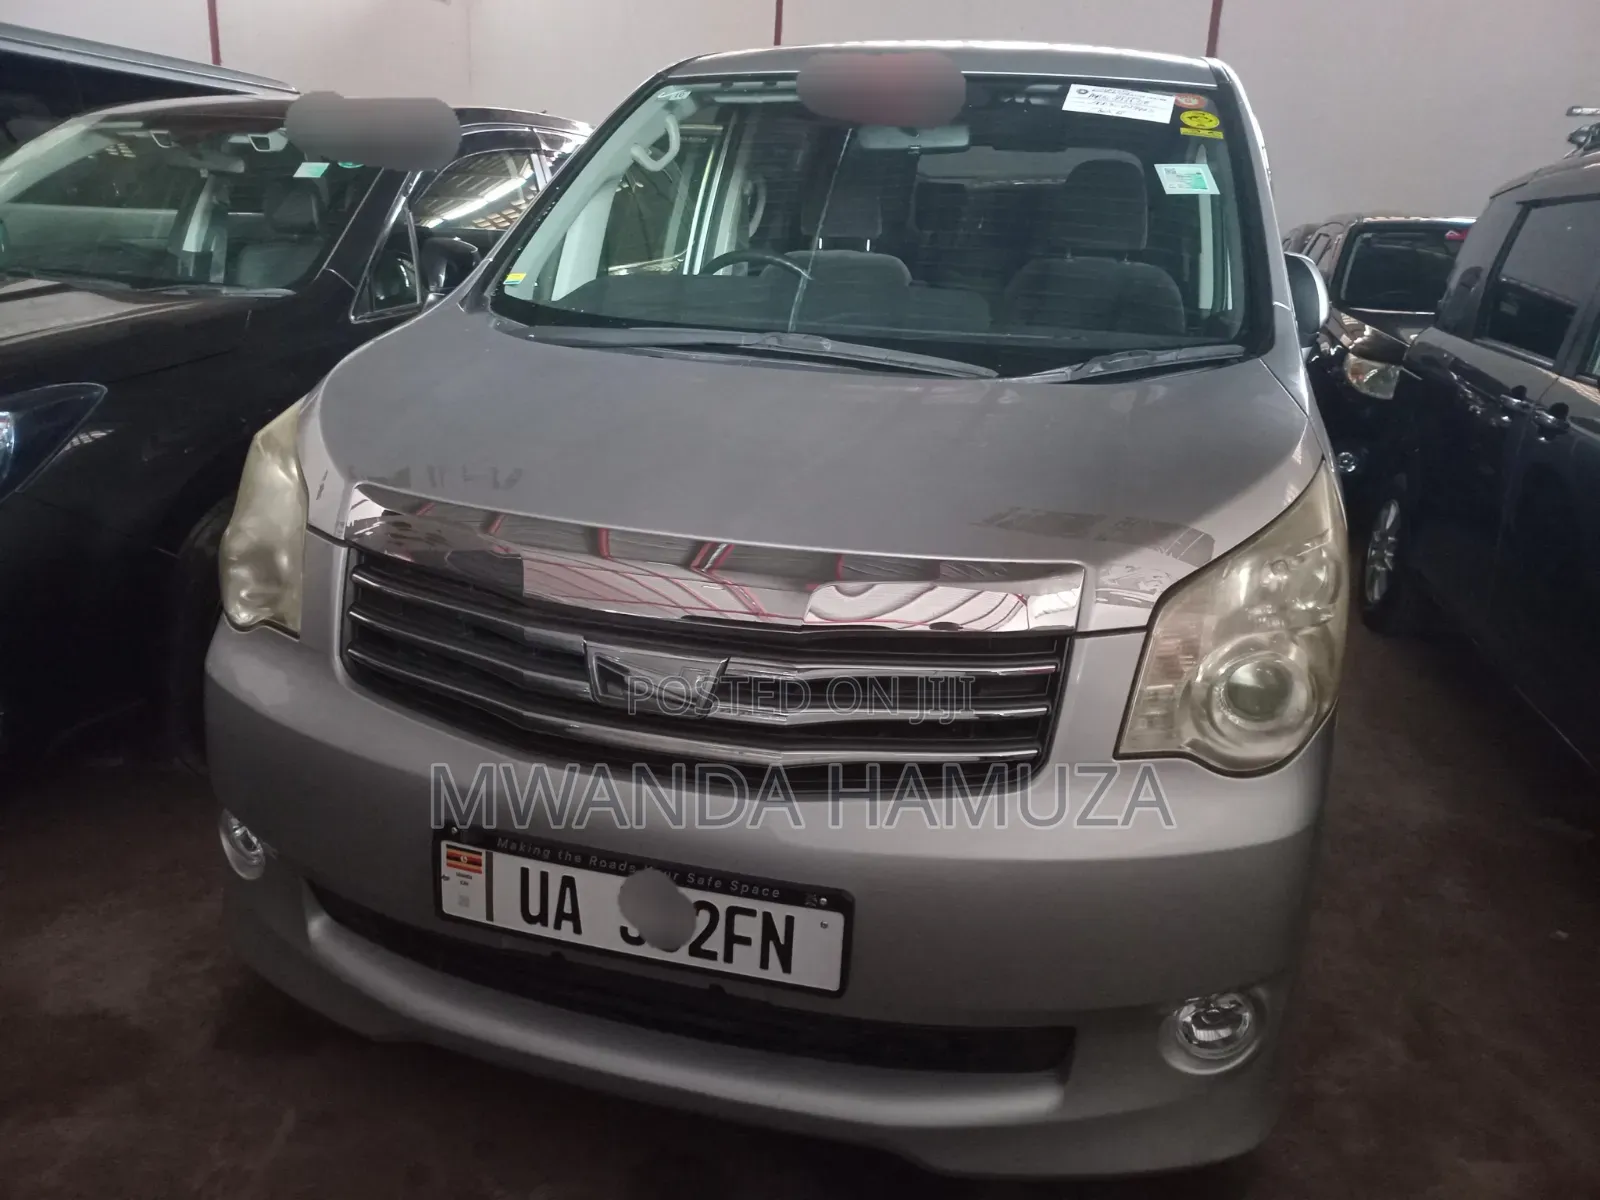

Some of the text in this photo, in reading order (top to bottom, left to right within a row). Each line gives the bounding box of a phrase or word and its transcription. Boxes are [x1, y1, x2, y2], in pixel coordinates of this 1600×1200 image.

[497, 837, 551, 860] Making
[558, 850, 582, 864] the
[589, 855, 637, 874] Roads
[687, 872, 722, 889] Safe
[729, 880, 781, 899] Space
[520, 866, 796, 975] UA 2FN
